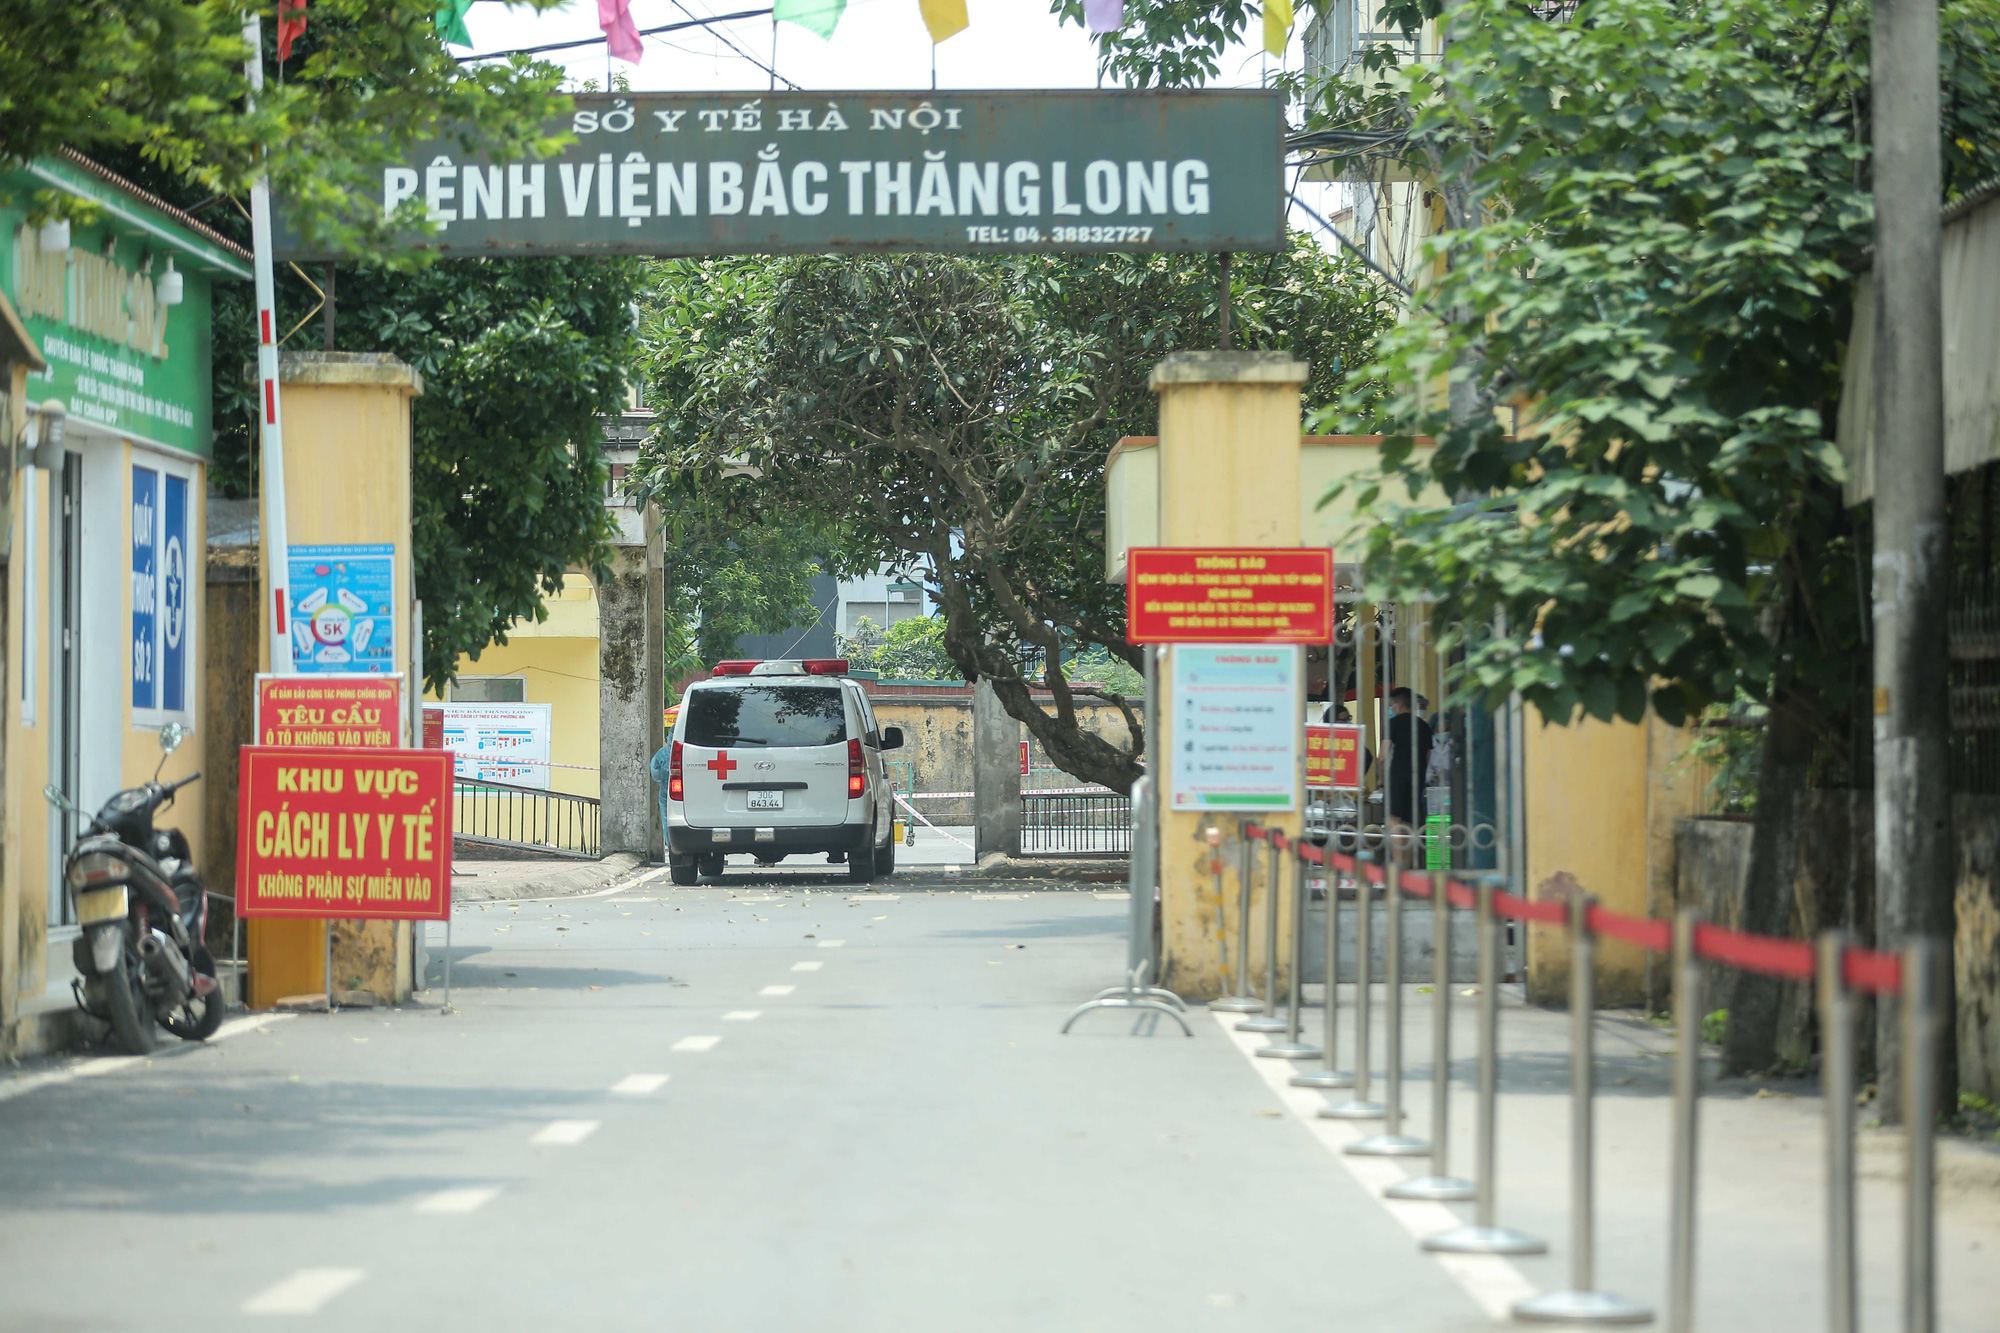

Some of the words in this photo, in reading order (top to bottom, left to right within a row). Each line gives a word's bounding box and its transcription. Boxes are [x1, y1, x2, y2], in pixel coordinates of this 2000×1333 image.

[573, 99, 635, 133] SỞ
[653, 110, 686, 132] Y
[698, 99, 762, 132] TẾ
[777, 101, 849, 131] HÀ
[869, 101, 962, 135] NỘI
[384, 155, 545, 231] BỆNH
[559, 152, 698, 227] VIỆN
[708, 143, 829, 216] BẮC
[839, 150, 1041, 216] THĂNG
[1052, 160, 1210, 216] LONG
[967, 226, 1009, 243] TEL:
[1052, 226, 1153, 243] 38832727
[1196, 556, 1237, 569] THÔNG
[1239, 556, 1266, 569] BÁO
[324, 623, 343, 636] 5K
[145, 641, 151, 682] 2
[307, 688, 323, 699] CÔNG
[324, 688, 335, 699] TÁC
[336, 687, 356, 699] PHÒNG
[357, 686, 377, 699] CHỐNG
[277, 704, 326, 724] YÊU
[331, 701, 381, 724] CẦU
[266, 728, 274, 745] Ô
[277, 728, 292, 745] TÔ
[295, 728, 335, 745] KHÔNG
[337, 727, 361, 745] VÀO
[363, 727, 391, 747] VIỆN
[277, 768, 344, 793] KHU
[354, 768, 419, 799] VỰC
[758, 791, 773, 799] 30G
[256, 801, 330, 859] CÁCH
[338, 813, 370, 859] LY
[378, 814, 395, 860] Y
[402, 798, 437, 861] TẾ
[258, 869, 304, 898] KHÔNG
[306, 870, 343, 905] PHẬN
[346, 873, 366, 905] SỰ
[367, 867, 402, 901] MIỄN
[405, 872, 432, 901] VÀO
